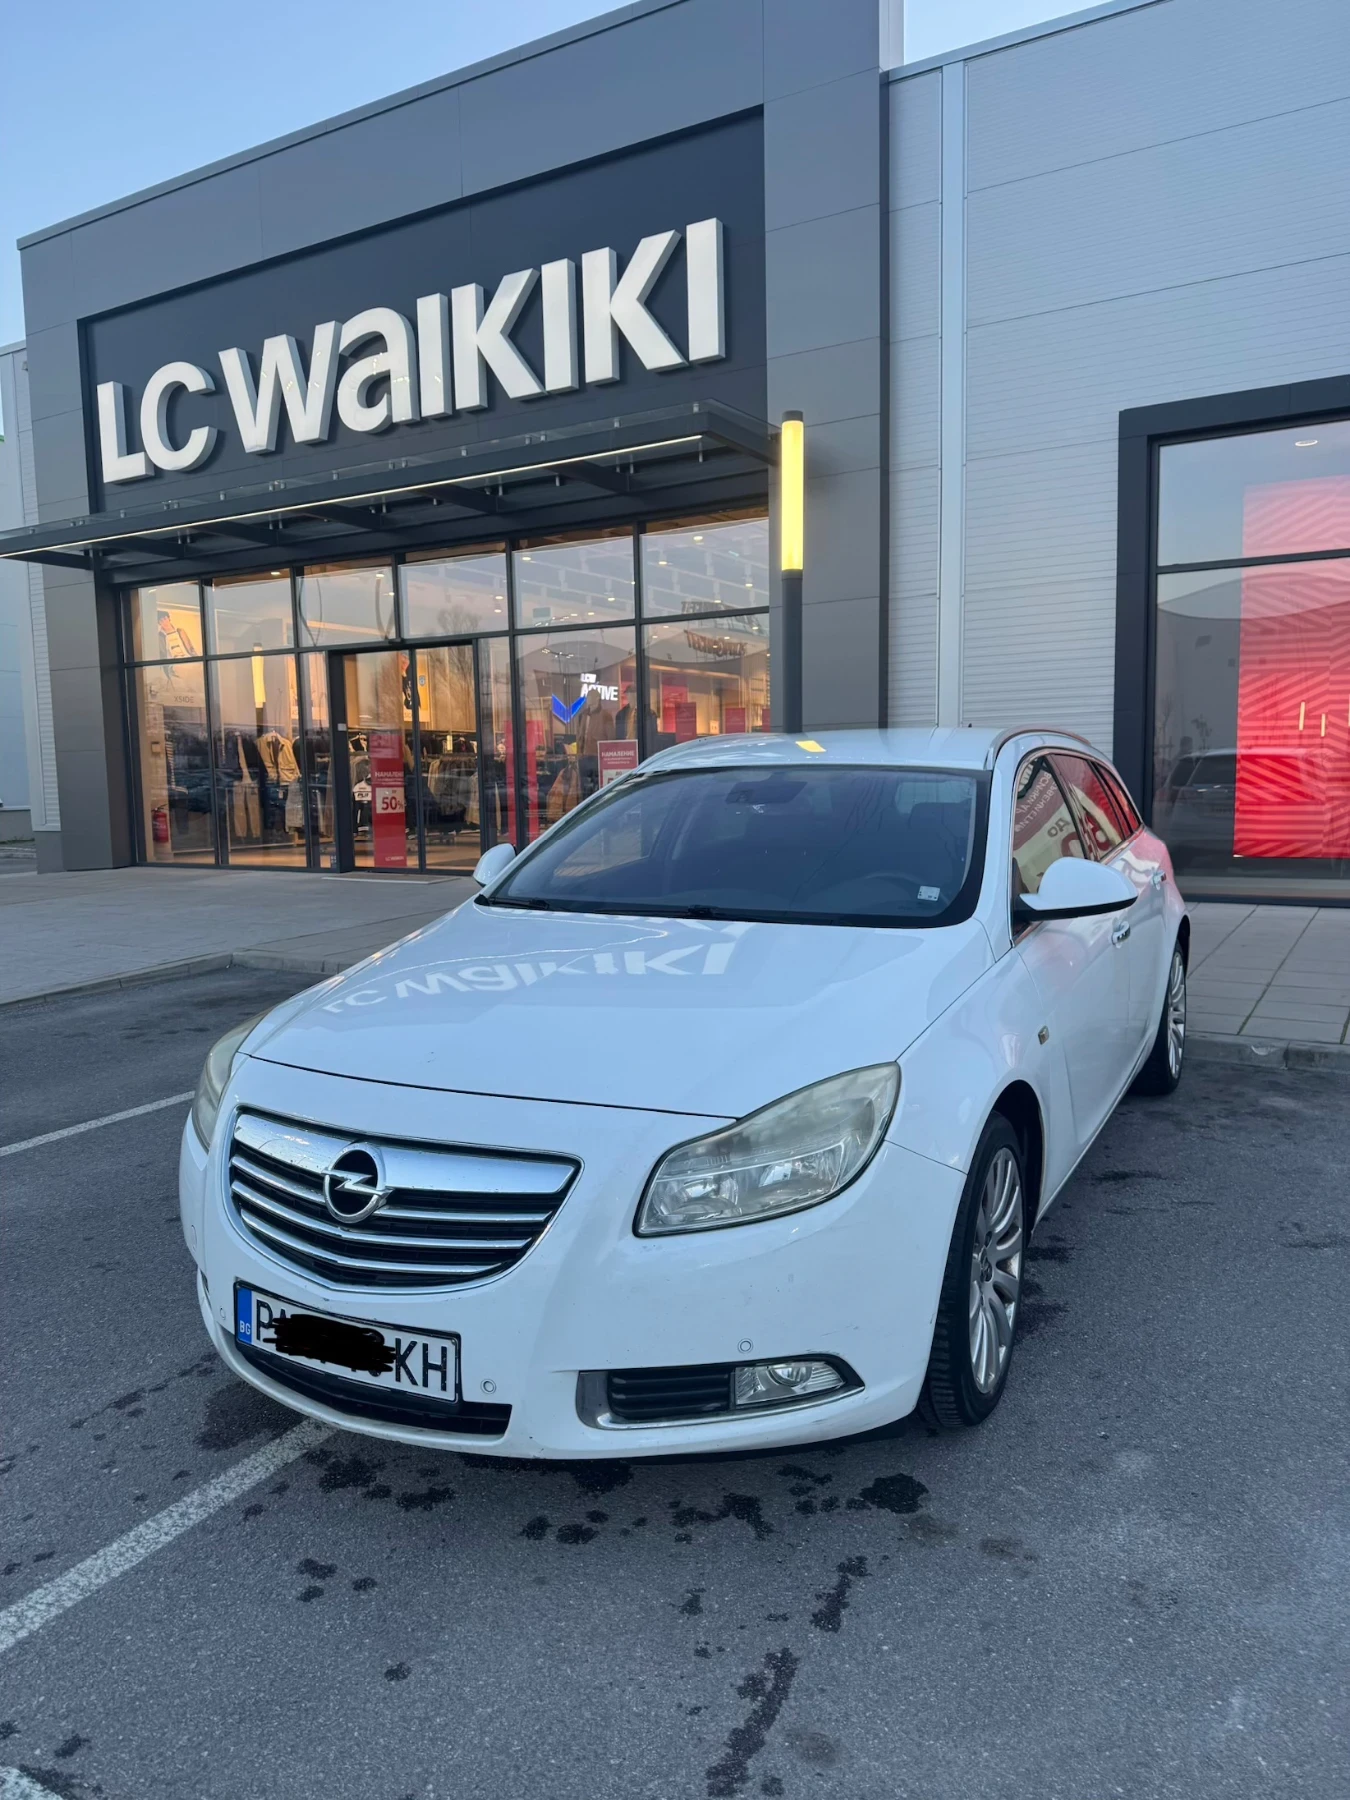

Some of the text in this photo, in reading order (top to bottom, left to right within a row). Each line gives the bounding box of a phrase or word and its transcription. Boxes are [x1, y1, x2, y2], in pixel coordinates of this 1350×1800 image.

[97, 361, 218, 484] LC
[240, 1320, 251, 1335] BG
[395, 1337, 448, 1392] KH
